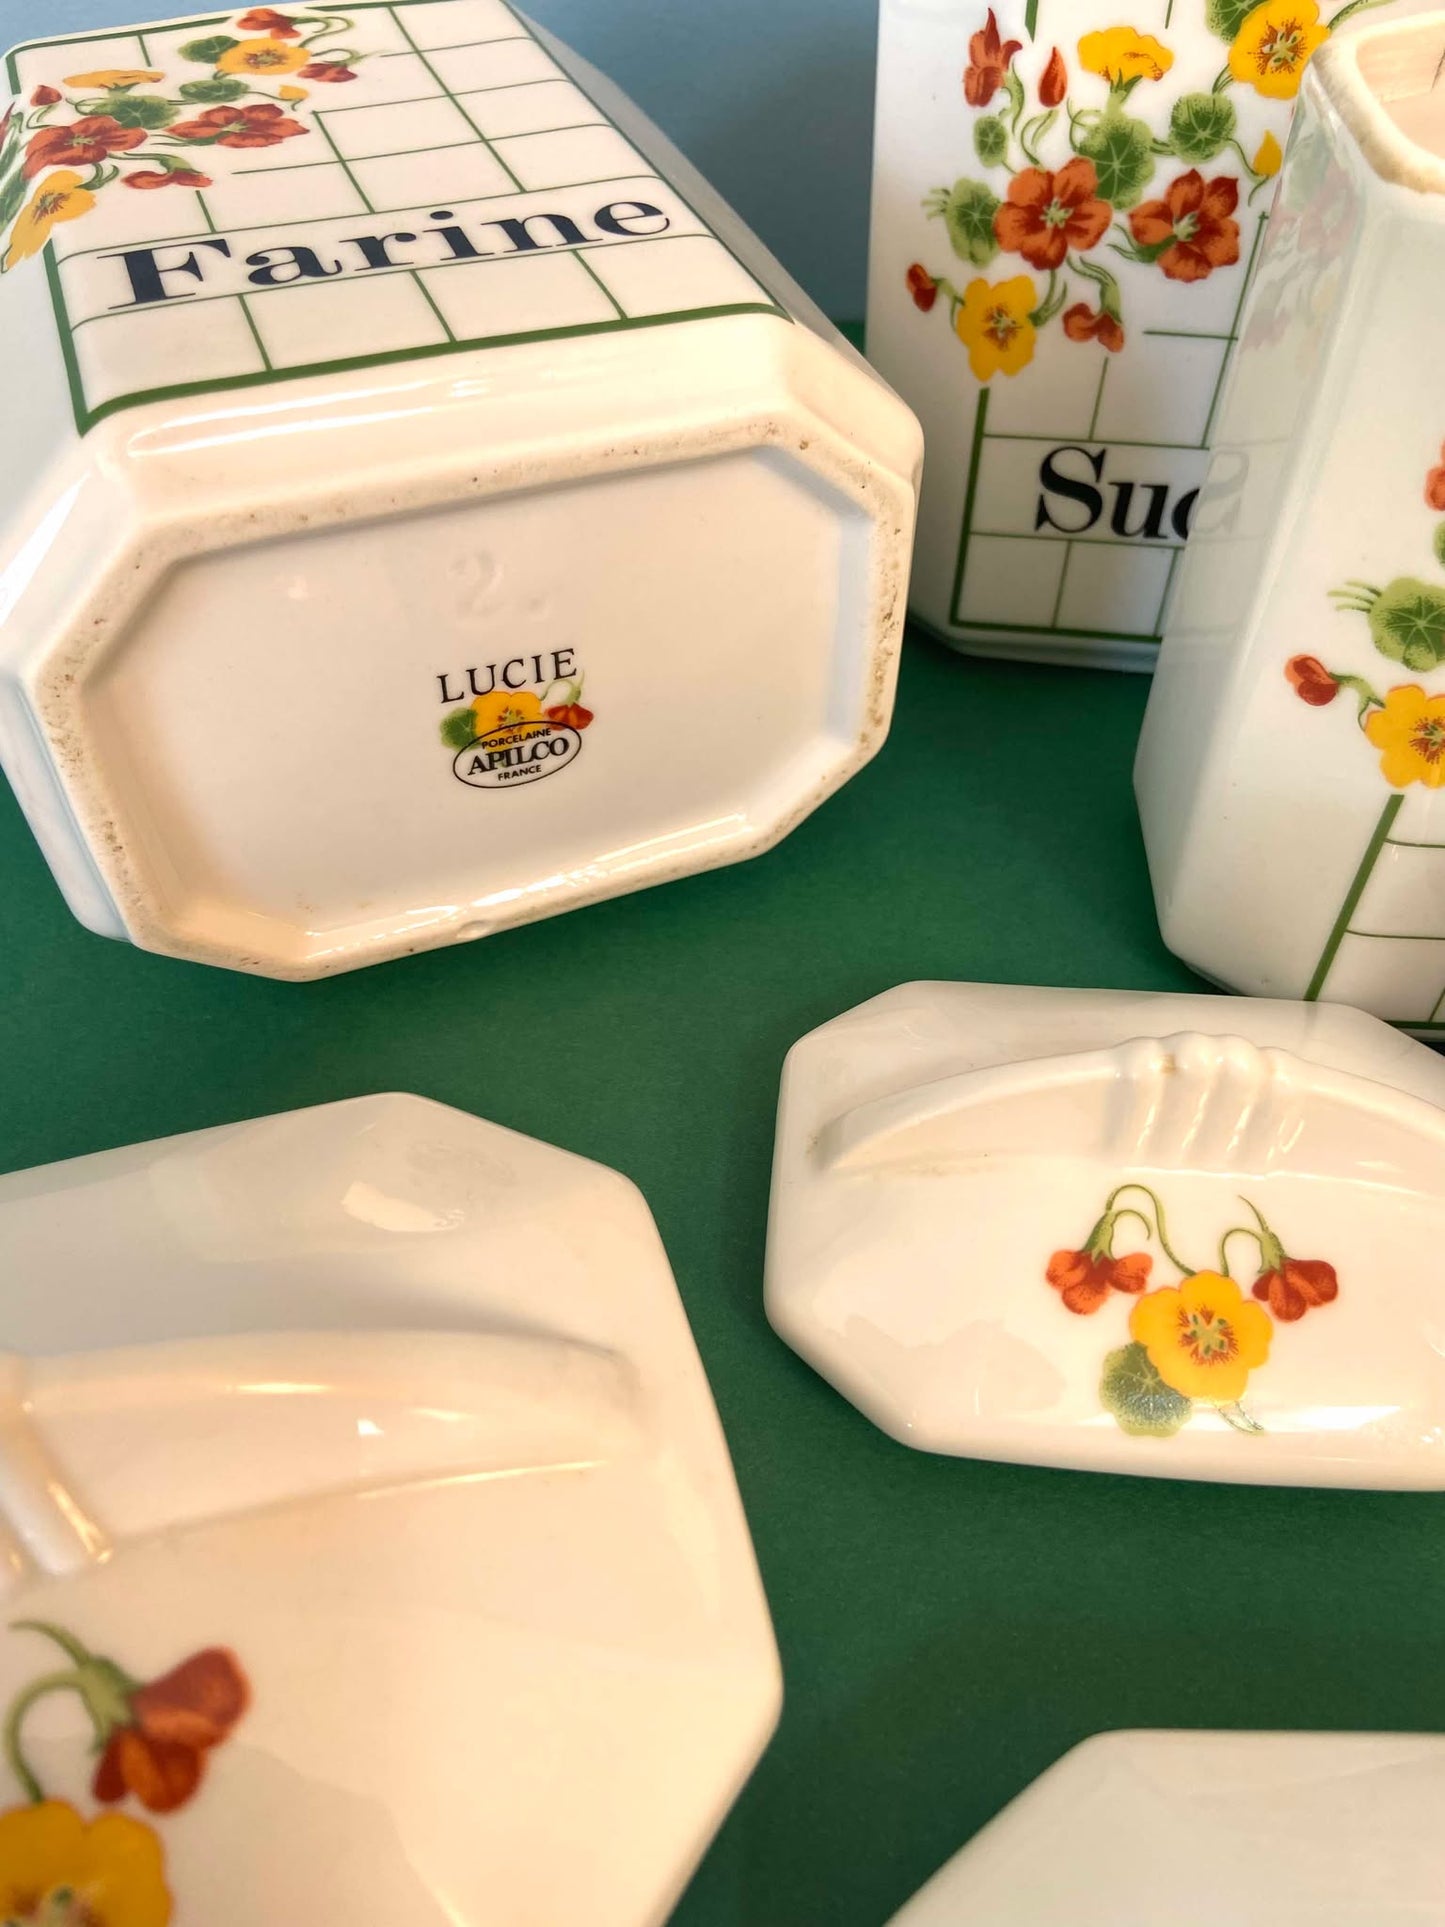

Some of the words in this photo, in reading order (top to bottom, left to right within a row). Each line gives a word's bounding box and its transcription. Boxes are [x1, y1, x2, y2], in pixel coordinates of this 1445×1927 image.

[97, 200, 670, 310] Farine
[436, 648, 577, 703] LUCIE
[467, 737, 570, 775] APILCO
[481, 727, 552, 749] PORCELAINE
[497, 764, 542, 781] FRANCE
